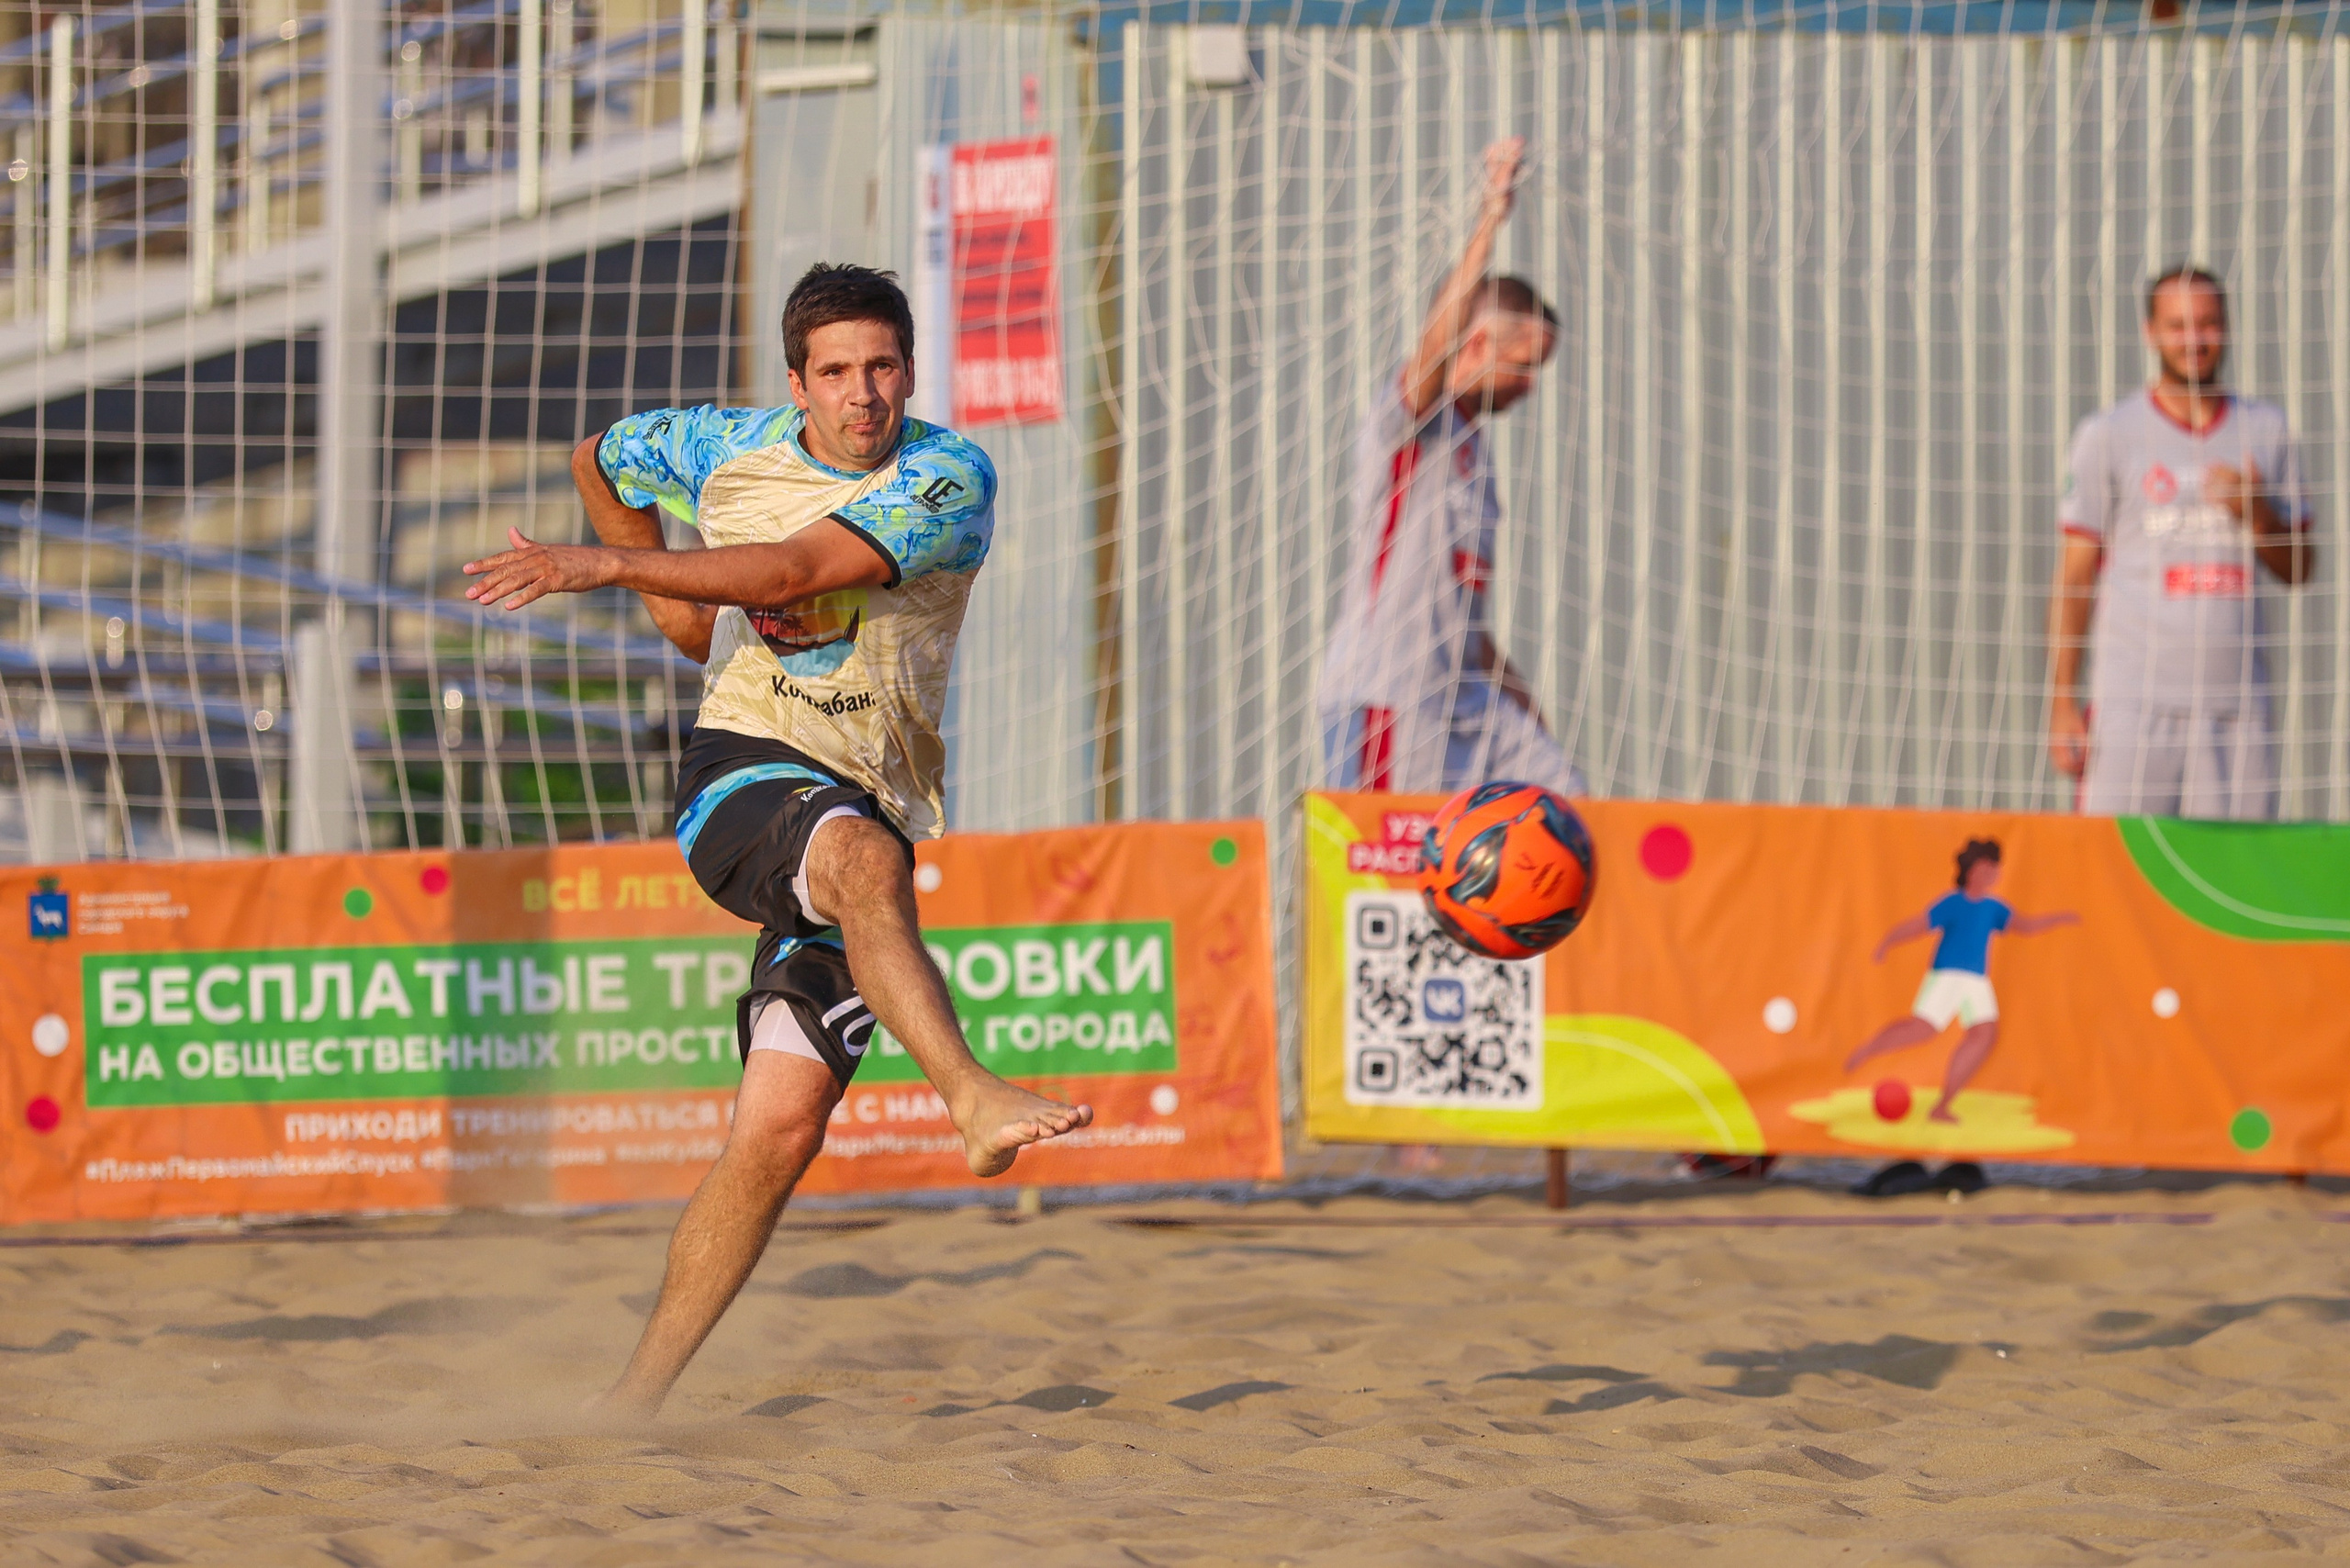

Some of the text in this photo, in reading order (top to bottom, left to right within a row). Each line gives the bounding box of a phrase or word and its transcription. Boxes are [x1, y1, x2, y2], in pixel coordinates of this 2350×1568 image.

[522, 868, 709, 912] ВСЁ ЛЕТ
[98, 935, 1165, 1027] БЕСПЛАТНЫЕ ТРОВКИ
[98, 1042, 164, 1082] НА
[176, 1029, 562, 1083] ОБЩЕСТВЕННЫХ
[985, 1009, 1173, 1055] ГОРОДА
[285, 1110, 442, 1144] ПРИХОДИ
[450, 1099, 719, 1138] ТРЕНИРОВАТЬСЯ
[855, 1092, 880, 1124] С
[883, 1091, 950, 1123] НАМ
